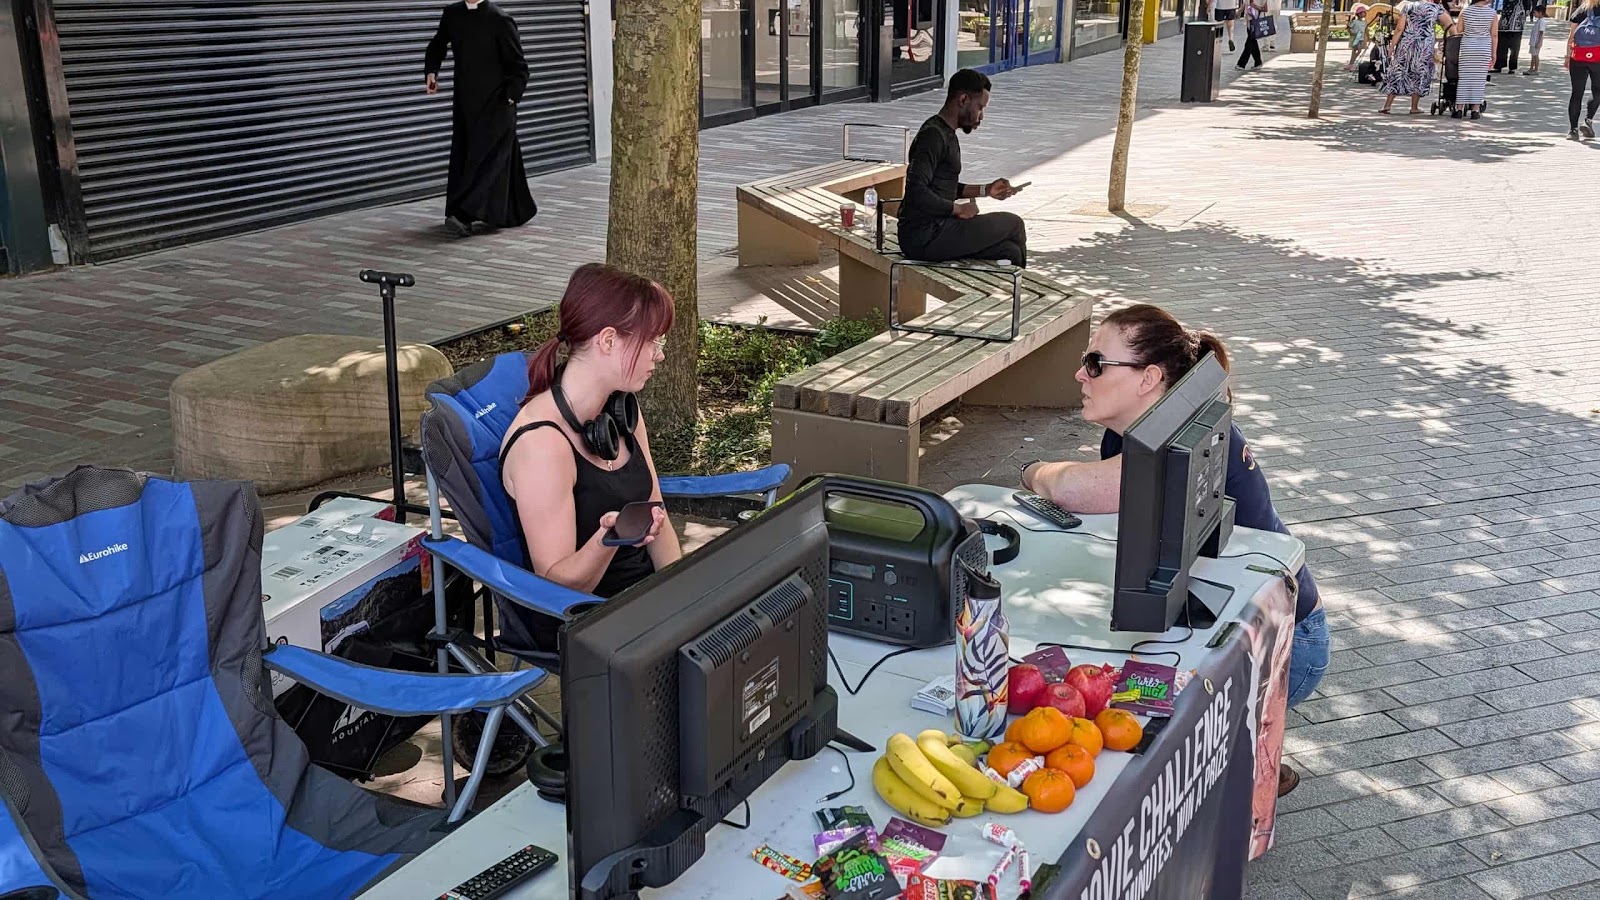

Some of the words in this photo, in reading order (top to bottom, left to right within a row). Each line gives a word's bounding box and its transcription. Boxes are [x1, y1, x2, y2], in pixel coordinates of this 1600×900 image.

[87, 543, 128, 561] Eurohike
[1081, 816, 1135, 900] OVIE
[1140, 676, 1233, 862] CHALLENGE
[1176, 788, 1195, 843] WIN
[1195, 775, 1202, 812] A
[1203, 734, 1229, 799] PRIZE
